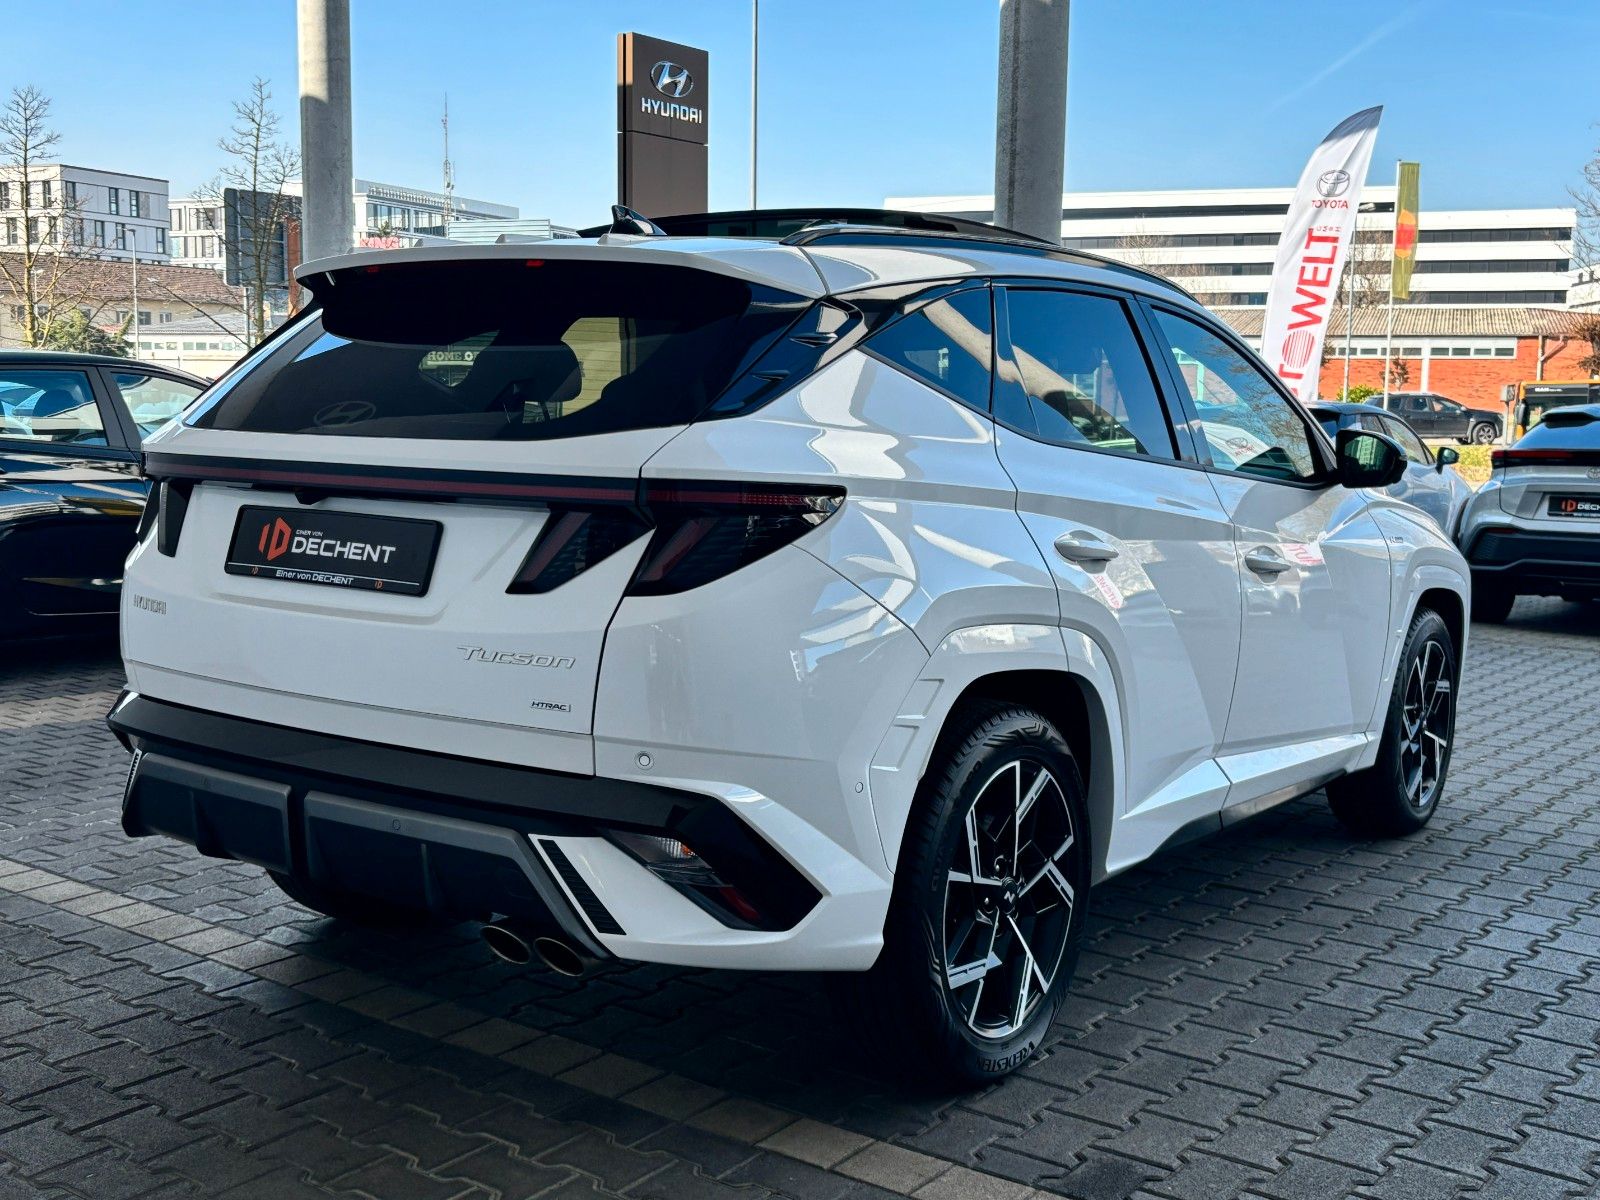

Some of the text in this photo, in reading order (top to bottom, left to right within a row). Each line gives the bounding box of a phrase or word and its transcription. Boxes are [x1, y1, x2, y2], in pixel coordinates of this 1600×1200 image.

[641, 97, 702, 123] HYUNDAI
[1311, 199, 1349, 209] TOYOTA
[291, 536, 396, 564] DECHENT
[276, 570, 354, 585] Einer von DECHENT
[134, 594, 167, 615] HYUNDAI
[531, 700, 567, 711] HTRAC
